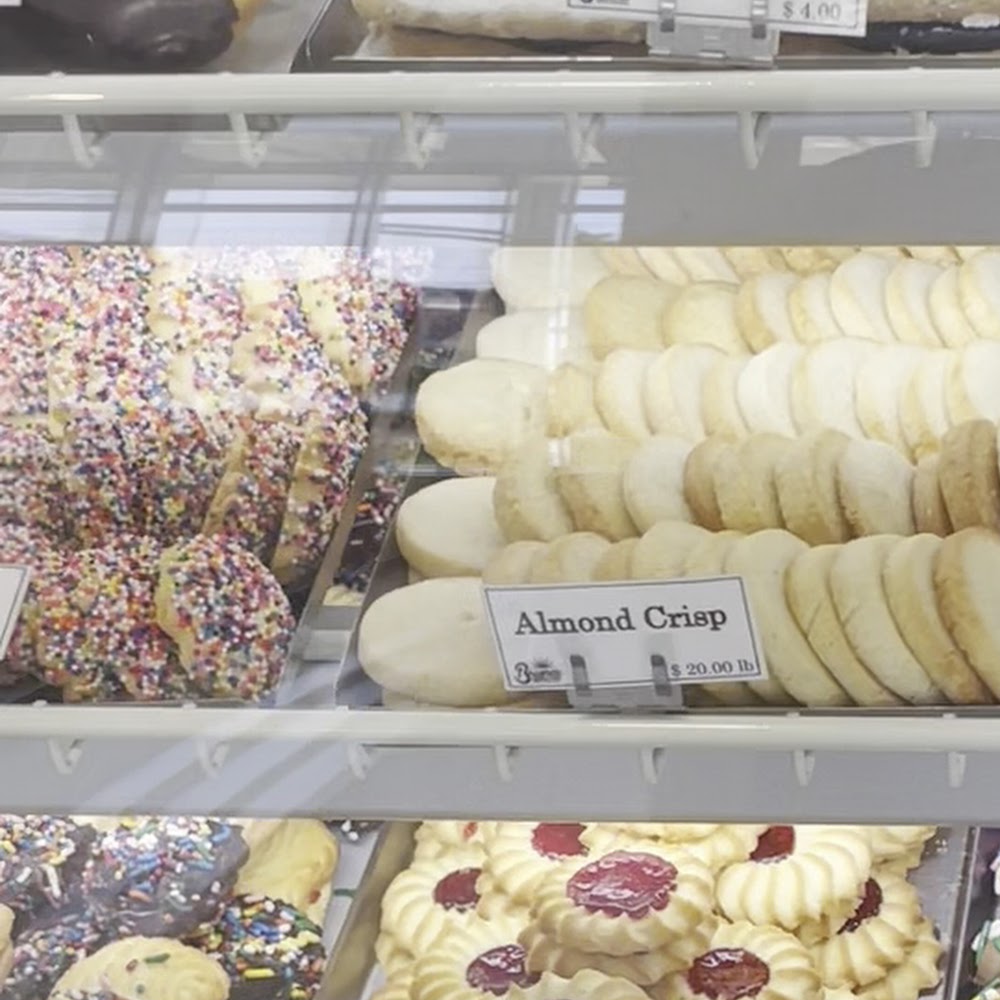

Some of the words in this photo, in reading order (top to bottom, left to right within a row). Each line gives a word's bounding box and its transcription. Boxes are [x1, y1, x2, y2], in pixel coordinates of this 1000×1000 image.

[515, 608, 636, 635] Almond
[644, 606, 727, 632] Crisp
[671, 663, 682, 677] $
[687, 662, 733, 676] 20.00
[738, 659, 754, 672] lb
